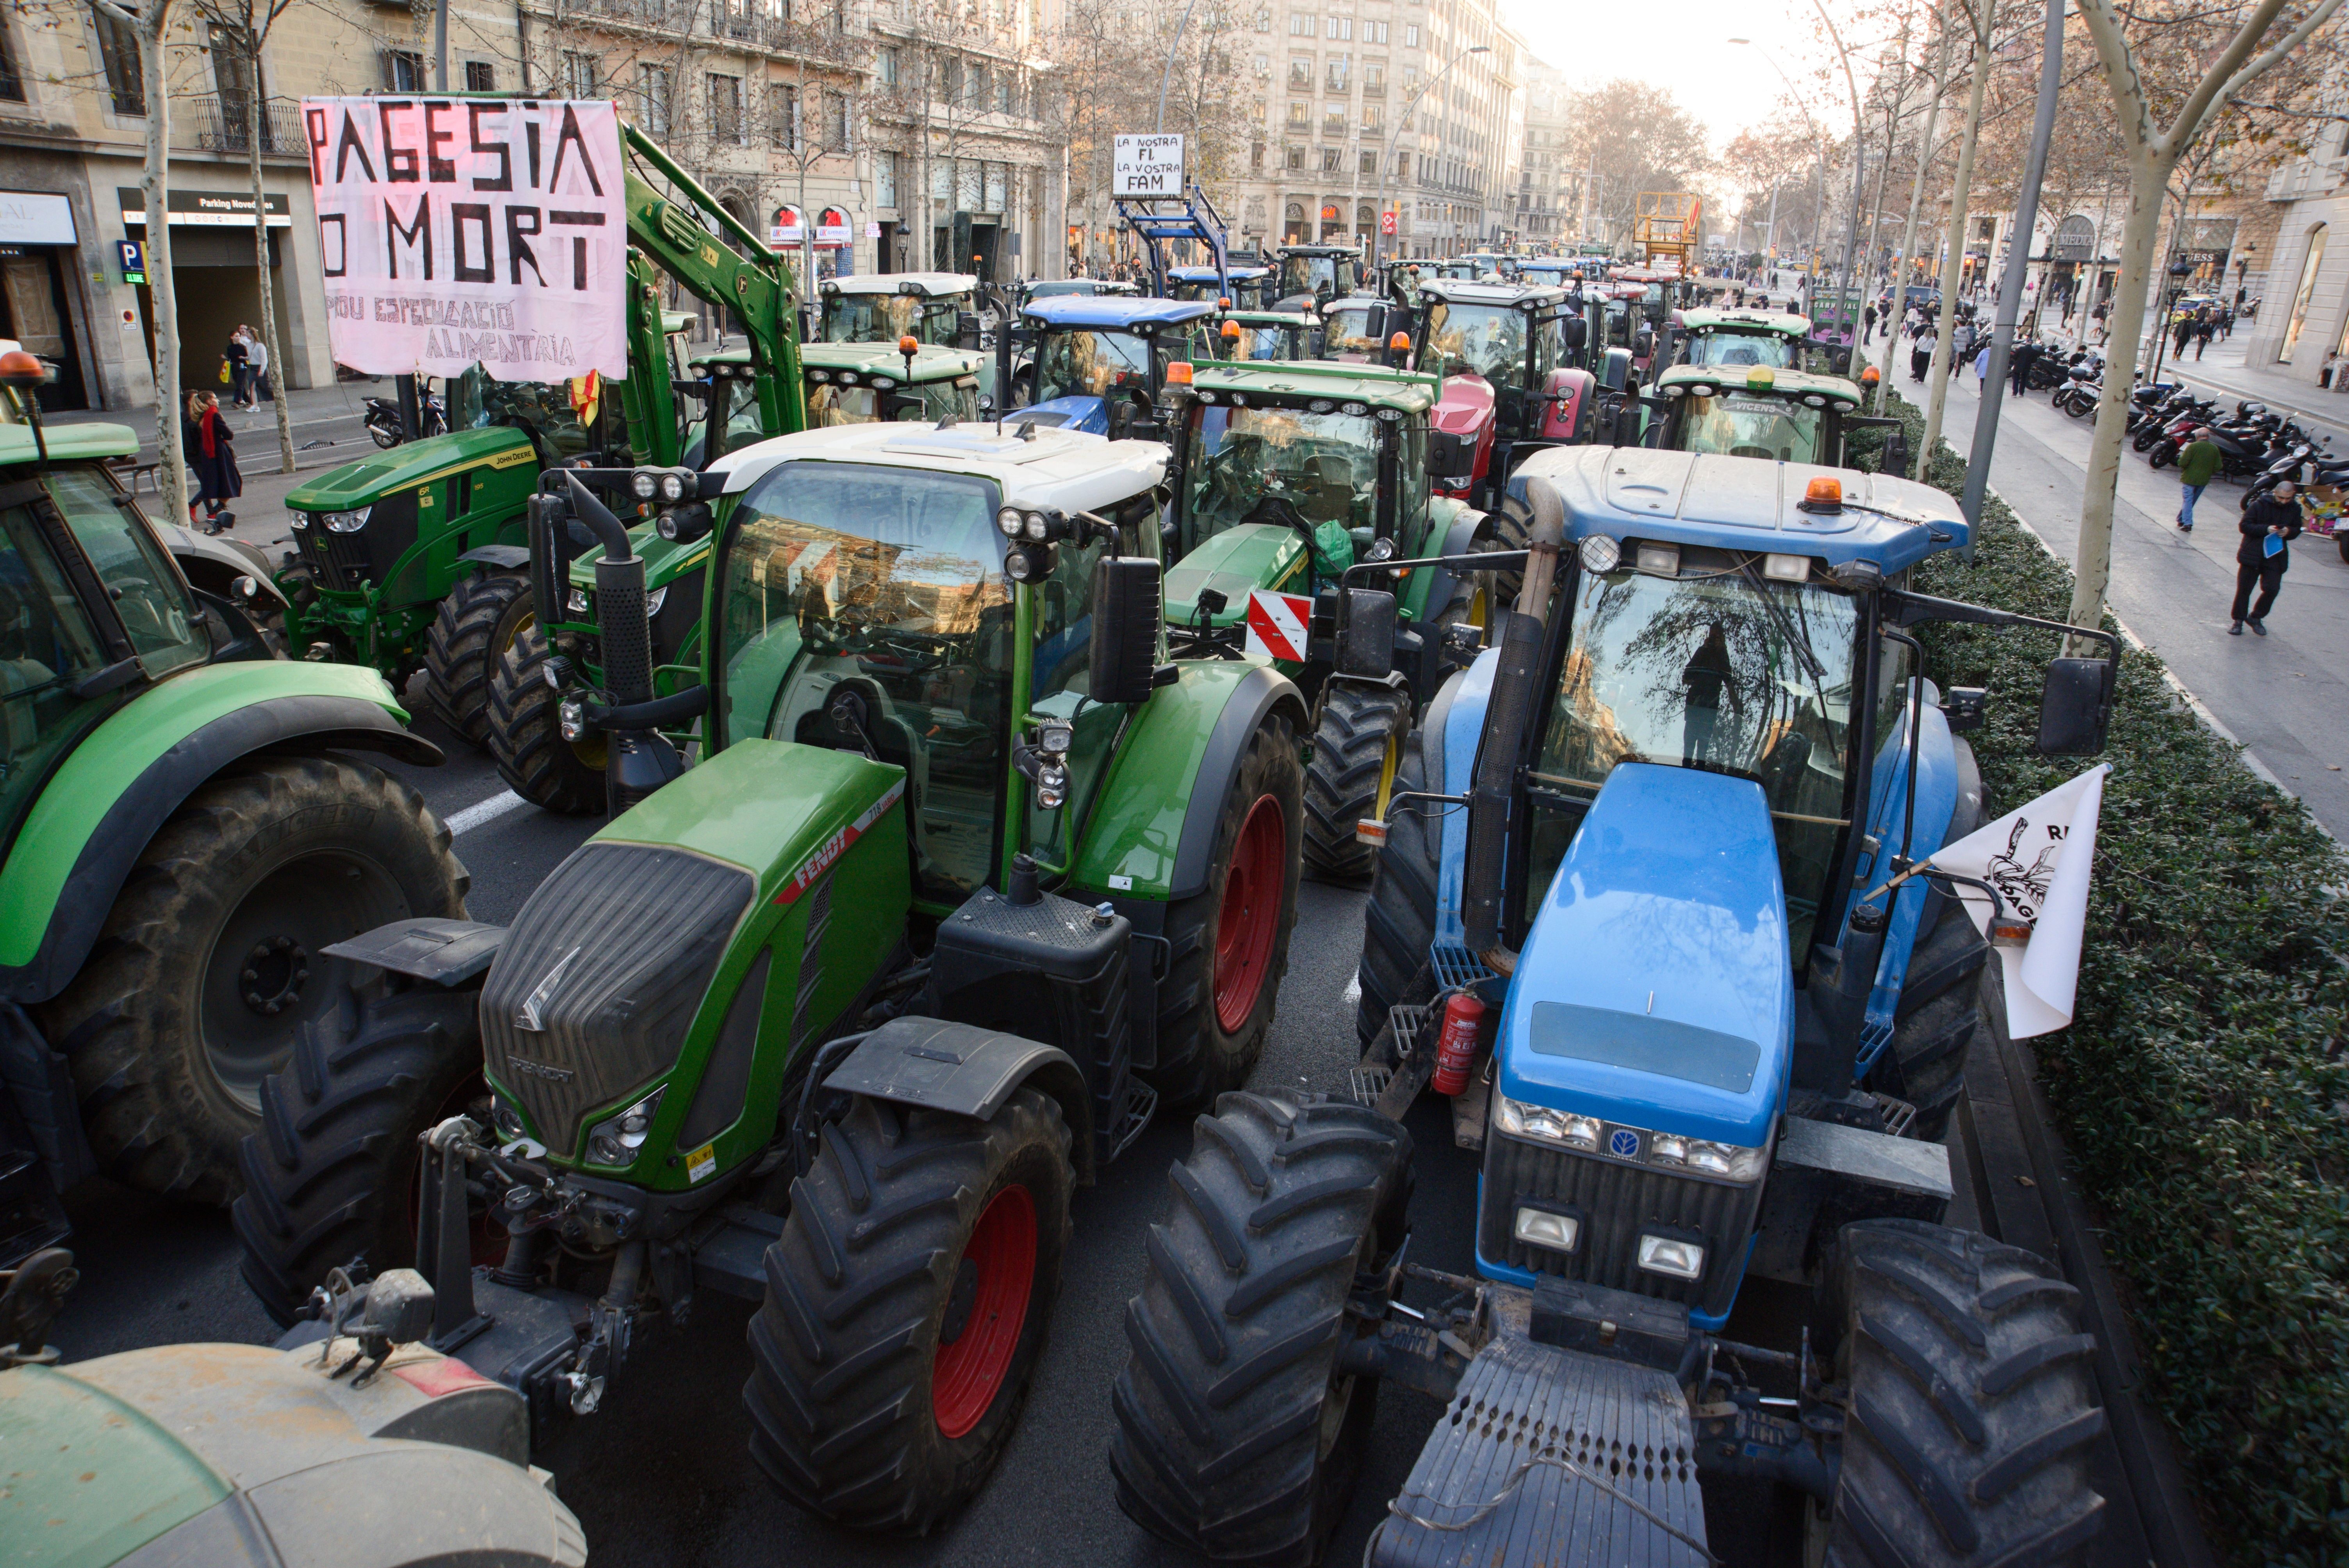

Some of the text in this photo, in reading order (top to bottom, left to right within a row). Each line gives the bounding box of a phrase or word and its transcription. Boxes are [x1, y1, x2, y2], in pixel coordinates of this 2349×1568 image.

[1118, 137, 1178, 147] LA NOSTRA
[1139, 148, 1155, 161] FI,
[1117, 162, 1180, 174] LA VOSTRA
[1128, 175, 1163, 190] FAM
[200, 198, 273, 210] Parking Novedes
[320, 191, 606, 290] O MORT
[1736, 401, 1776, 413] VICENS
[497, 450, 531, 465] JOHN DEERE
[419, 486, 430, 496] 6R
[794, 824, 845, 889] FENDT
[868, 802, 882, 821] 718
[882, 794, 895, 810] VARIO
[508, 1056, 574, 1083] FENDT
